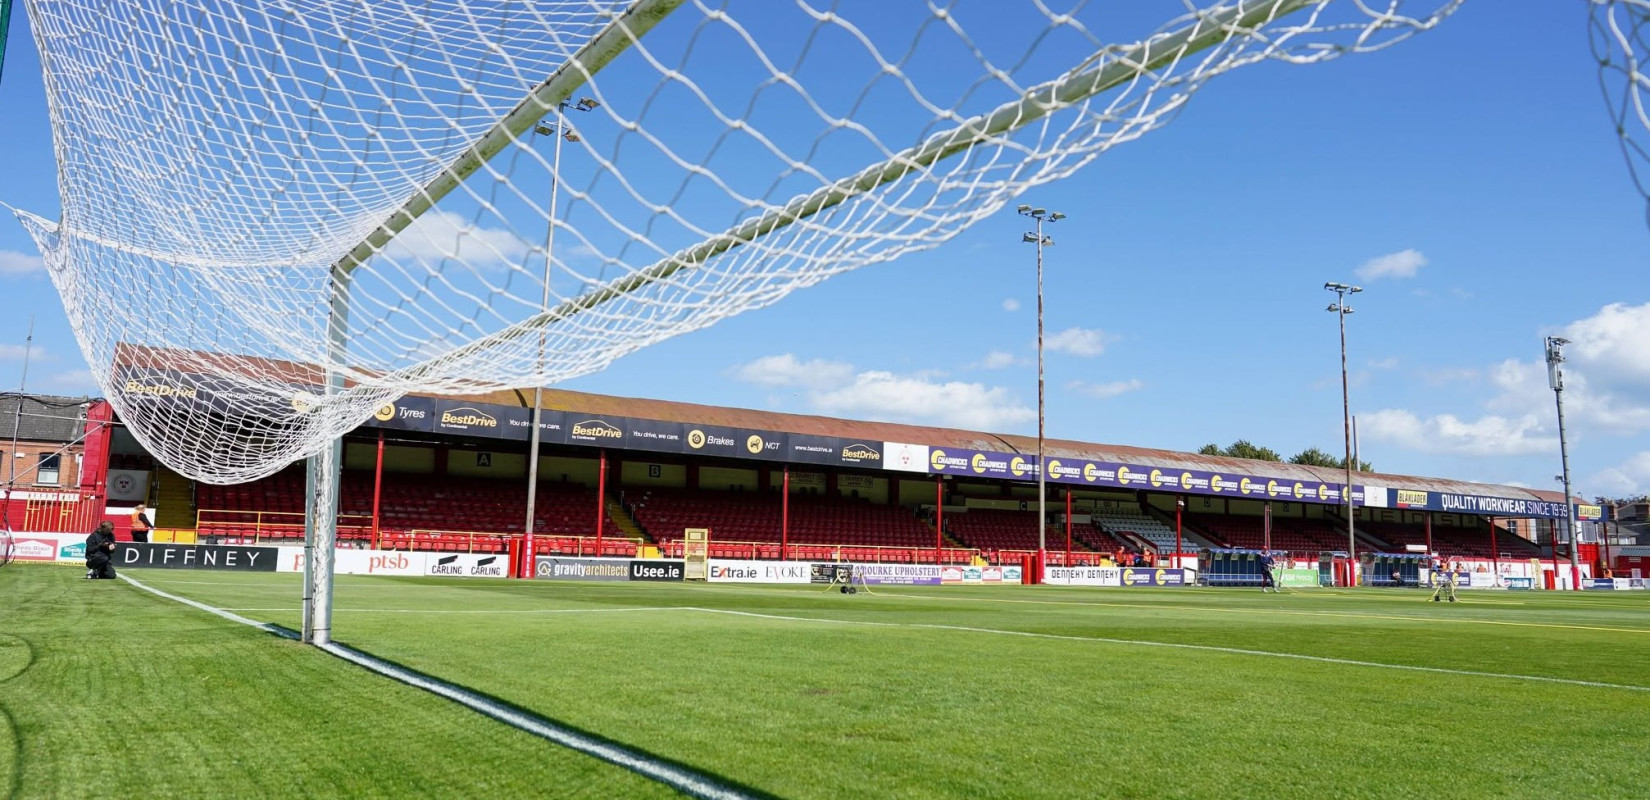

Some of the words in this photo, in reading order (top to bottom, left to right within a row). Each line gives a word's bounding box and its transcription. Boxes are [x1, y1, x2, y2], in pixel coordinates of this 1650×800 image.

[399, 407, 426, 419] Tyres
[441, 412, 498, 427] BestDrive
[572, 425, 622, 438] BestDrive
[707, 436, 735, 446] Brakes
[764, 442, 780, 450] NCT
[479, 455, 489, 465] A
[842, 448, 880, 460] BestDrive
[937, 456, 968, 466] CHADWICKS
[978, 459, 1007, 469] CHADWICKS
[651, 467, 659, 476] B
[1054, 466, 1081, 475] CHADWICKS
[1441, 494, 1477, 511] QUALITY
[1478, 497, 1526, 514] WORKWEAR
[1527, 501, 1550, 516] SINCE
[1550, 503, 1568, 517] 1959
[125, 547, 261, 567] DIFFNEY
[368, 553, 409, 573] ptsb
[431, 565, 463, 575] CARLING
[470, 566, 501, 576] CARLING
[554, 561, 629, 577] gravityarchitects
[633, 564, 680, 578] Usee.ie
[710, 565, 758, 579] Extra.ie
[765, 566, 807, 580] EVOKE
[894, 566, 941, 577] UPHOLSTERY
[1051, 569, 1085, 584] DENNEHY
[1087, 569, 1119, 584] DENNEHY
